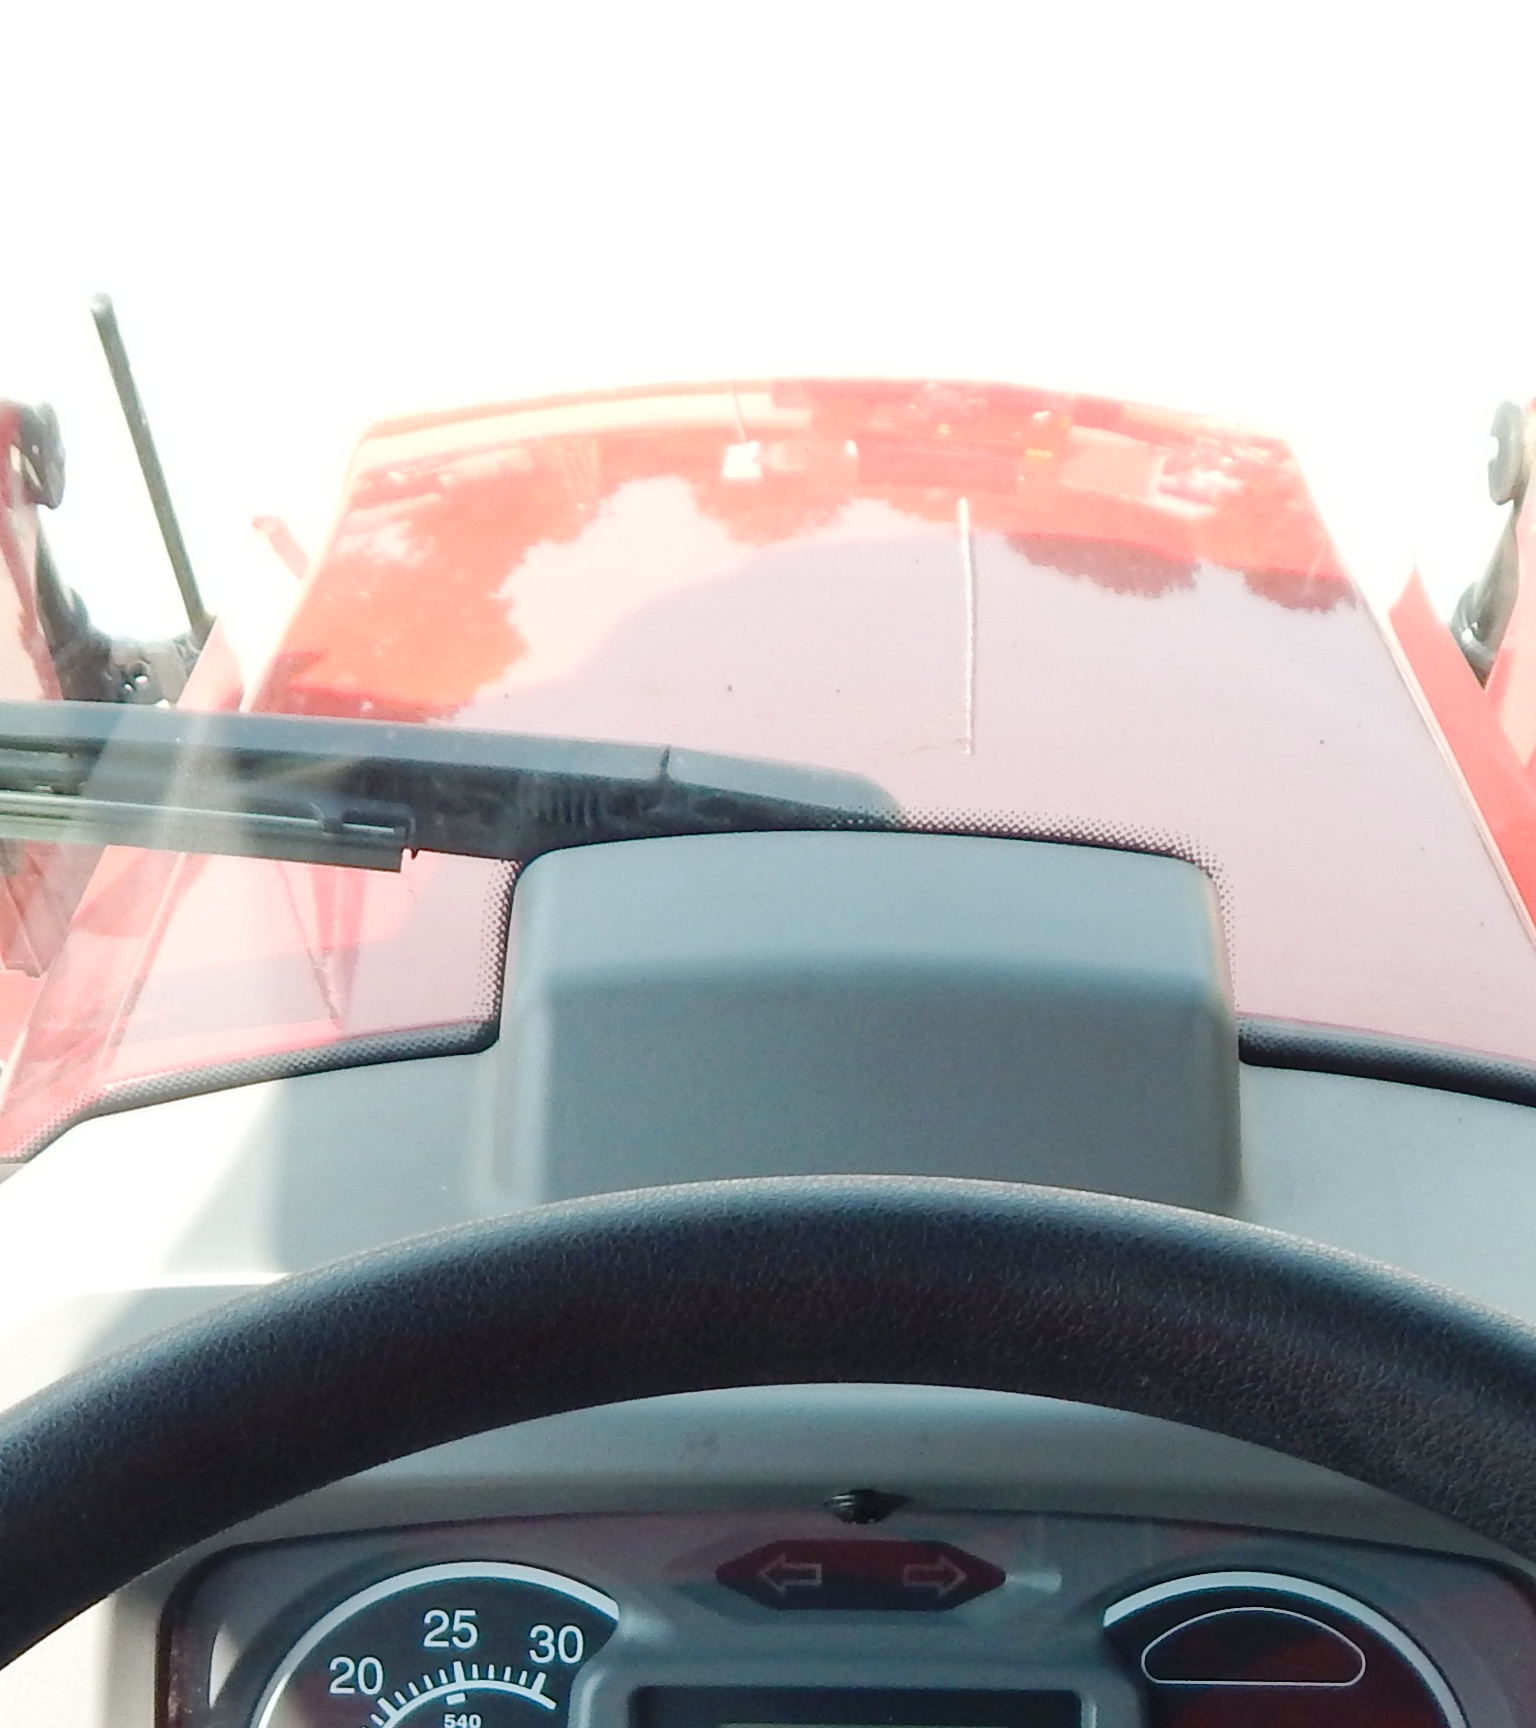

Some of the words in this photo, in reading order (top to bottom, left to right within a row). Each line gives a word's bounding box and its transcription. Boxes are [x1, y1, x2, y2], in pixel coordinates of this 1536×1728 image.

[423, 1610, 478, 1648] 25
[528, 1625, 584, 1664] 30
[329, 1656, 383, 1695] 20
